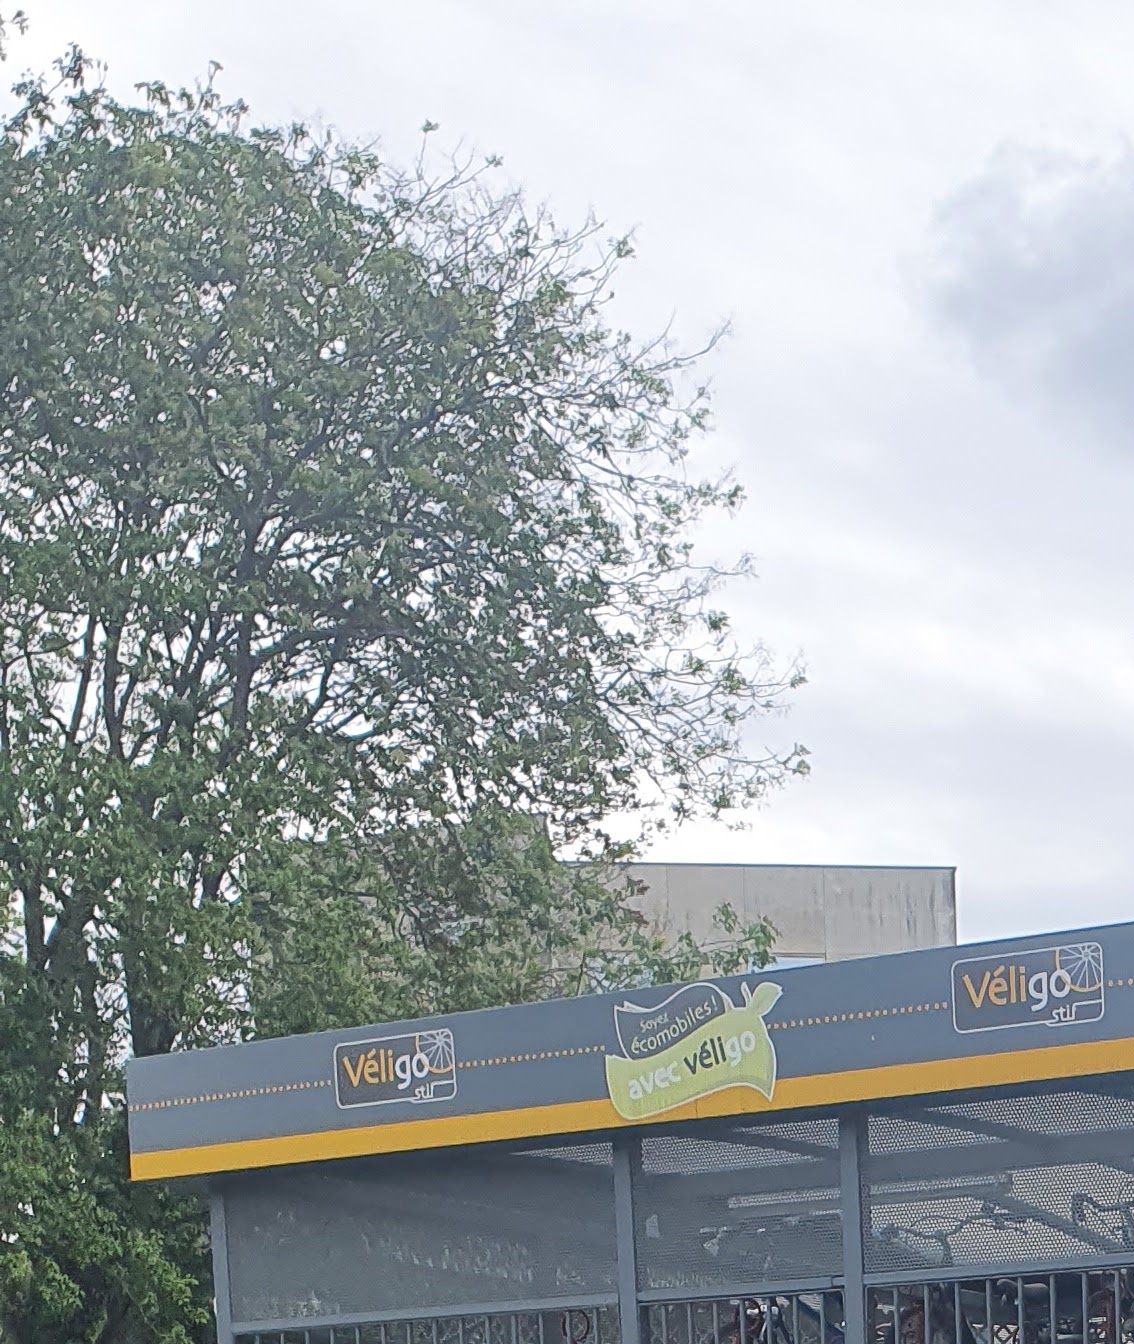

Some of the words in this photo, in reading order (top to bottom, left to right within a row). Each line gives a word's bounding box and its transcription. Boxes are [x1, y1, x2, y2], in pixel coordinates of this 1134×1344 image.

[961, 964, 1072, 1013] Véligo
[640, 1012, 670, 1035] Soyez
[342, 1047, 430, 1091] Véligo
[627, 1060, 682, 1100] avec
[683, 1030, 757, 1076] véligo
